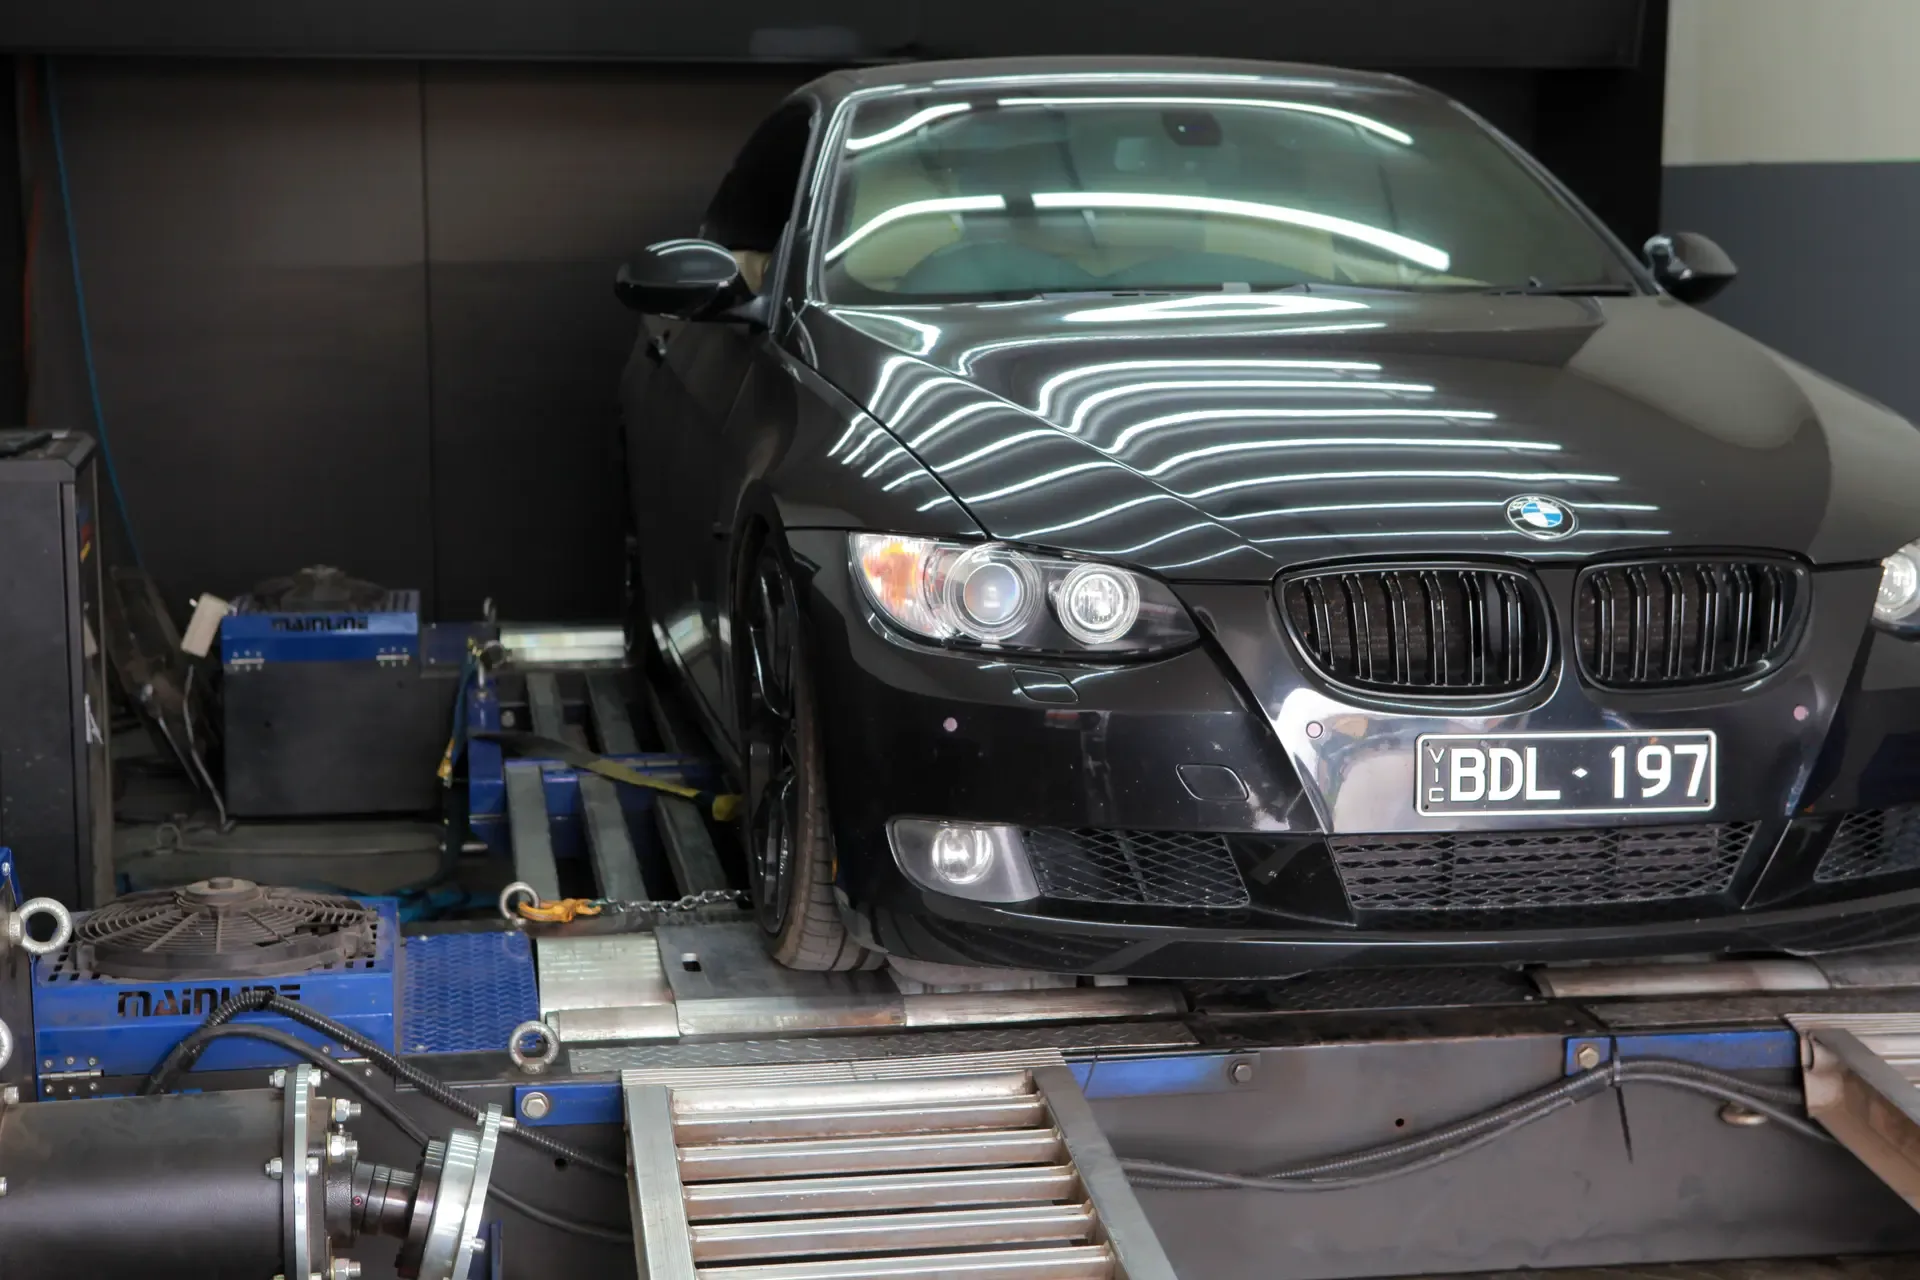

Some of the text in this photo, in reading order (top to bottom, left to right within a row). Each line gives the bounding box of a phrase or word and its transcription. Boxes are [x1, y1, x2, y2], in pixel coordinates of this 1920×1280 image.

[1428, 748, 1444, 802] VIC
[1451, 745, 1708, 801] BDL 197
